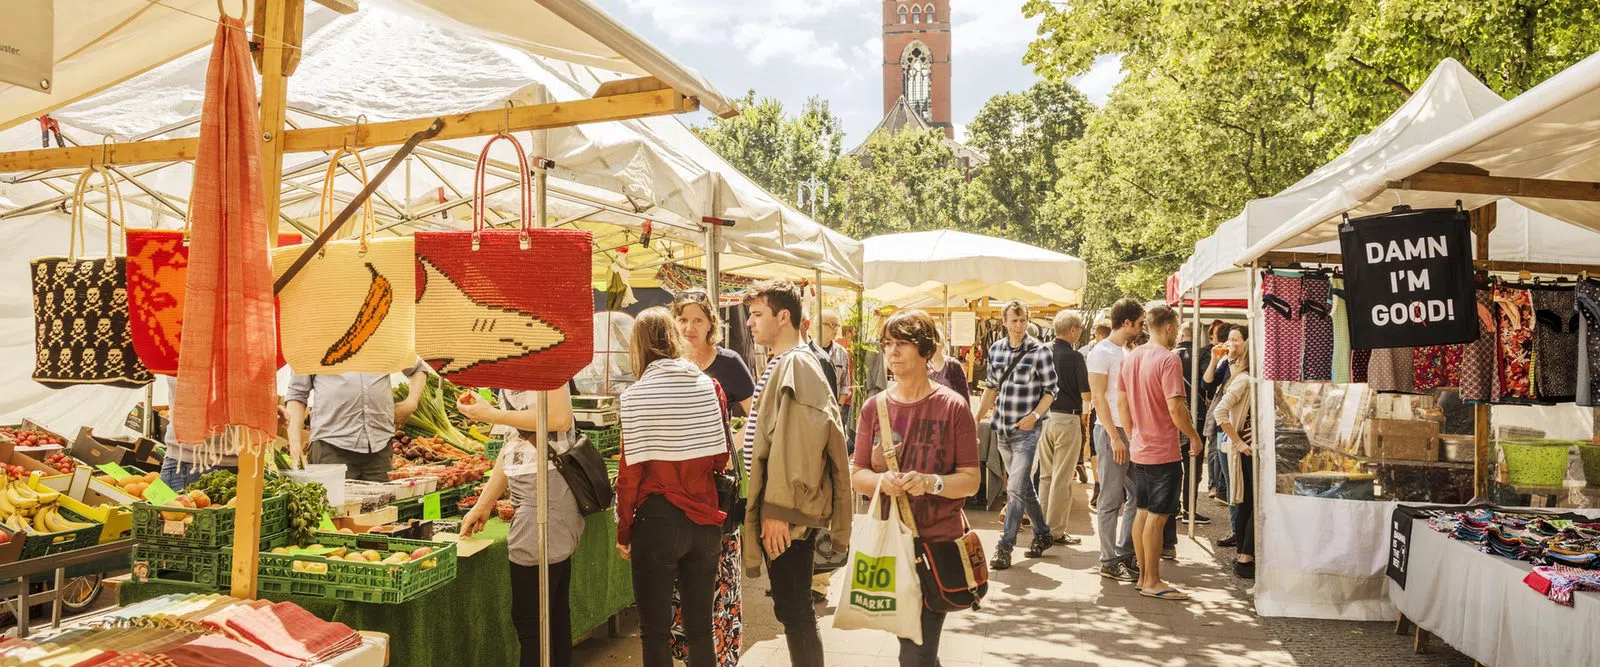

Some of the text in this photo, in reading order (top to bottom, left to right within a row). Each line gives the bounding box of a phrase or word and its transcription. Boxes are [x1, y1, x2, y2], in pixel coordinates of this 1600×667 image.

[1365, 235, 1448, 264] DAMN
[1390, 268, 1430, 293] I'M
[1371, 298, 1455, 326] GOOD!
[911, 419, 949, 445] HEY
[856, 559, 890, 588] Bio
[855, 593, 892, 609] MARKT
